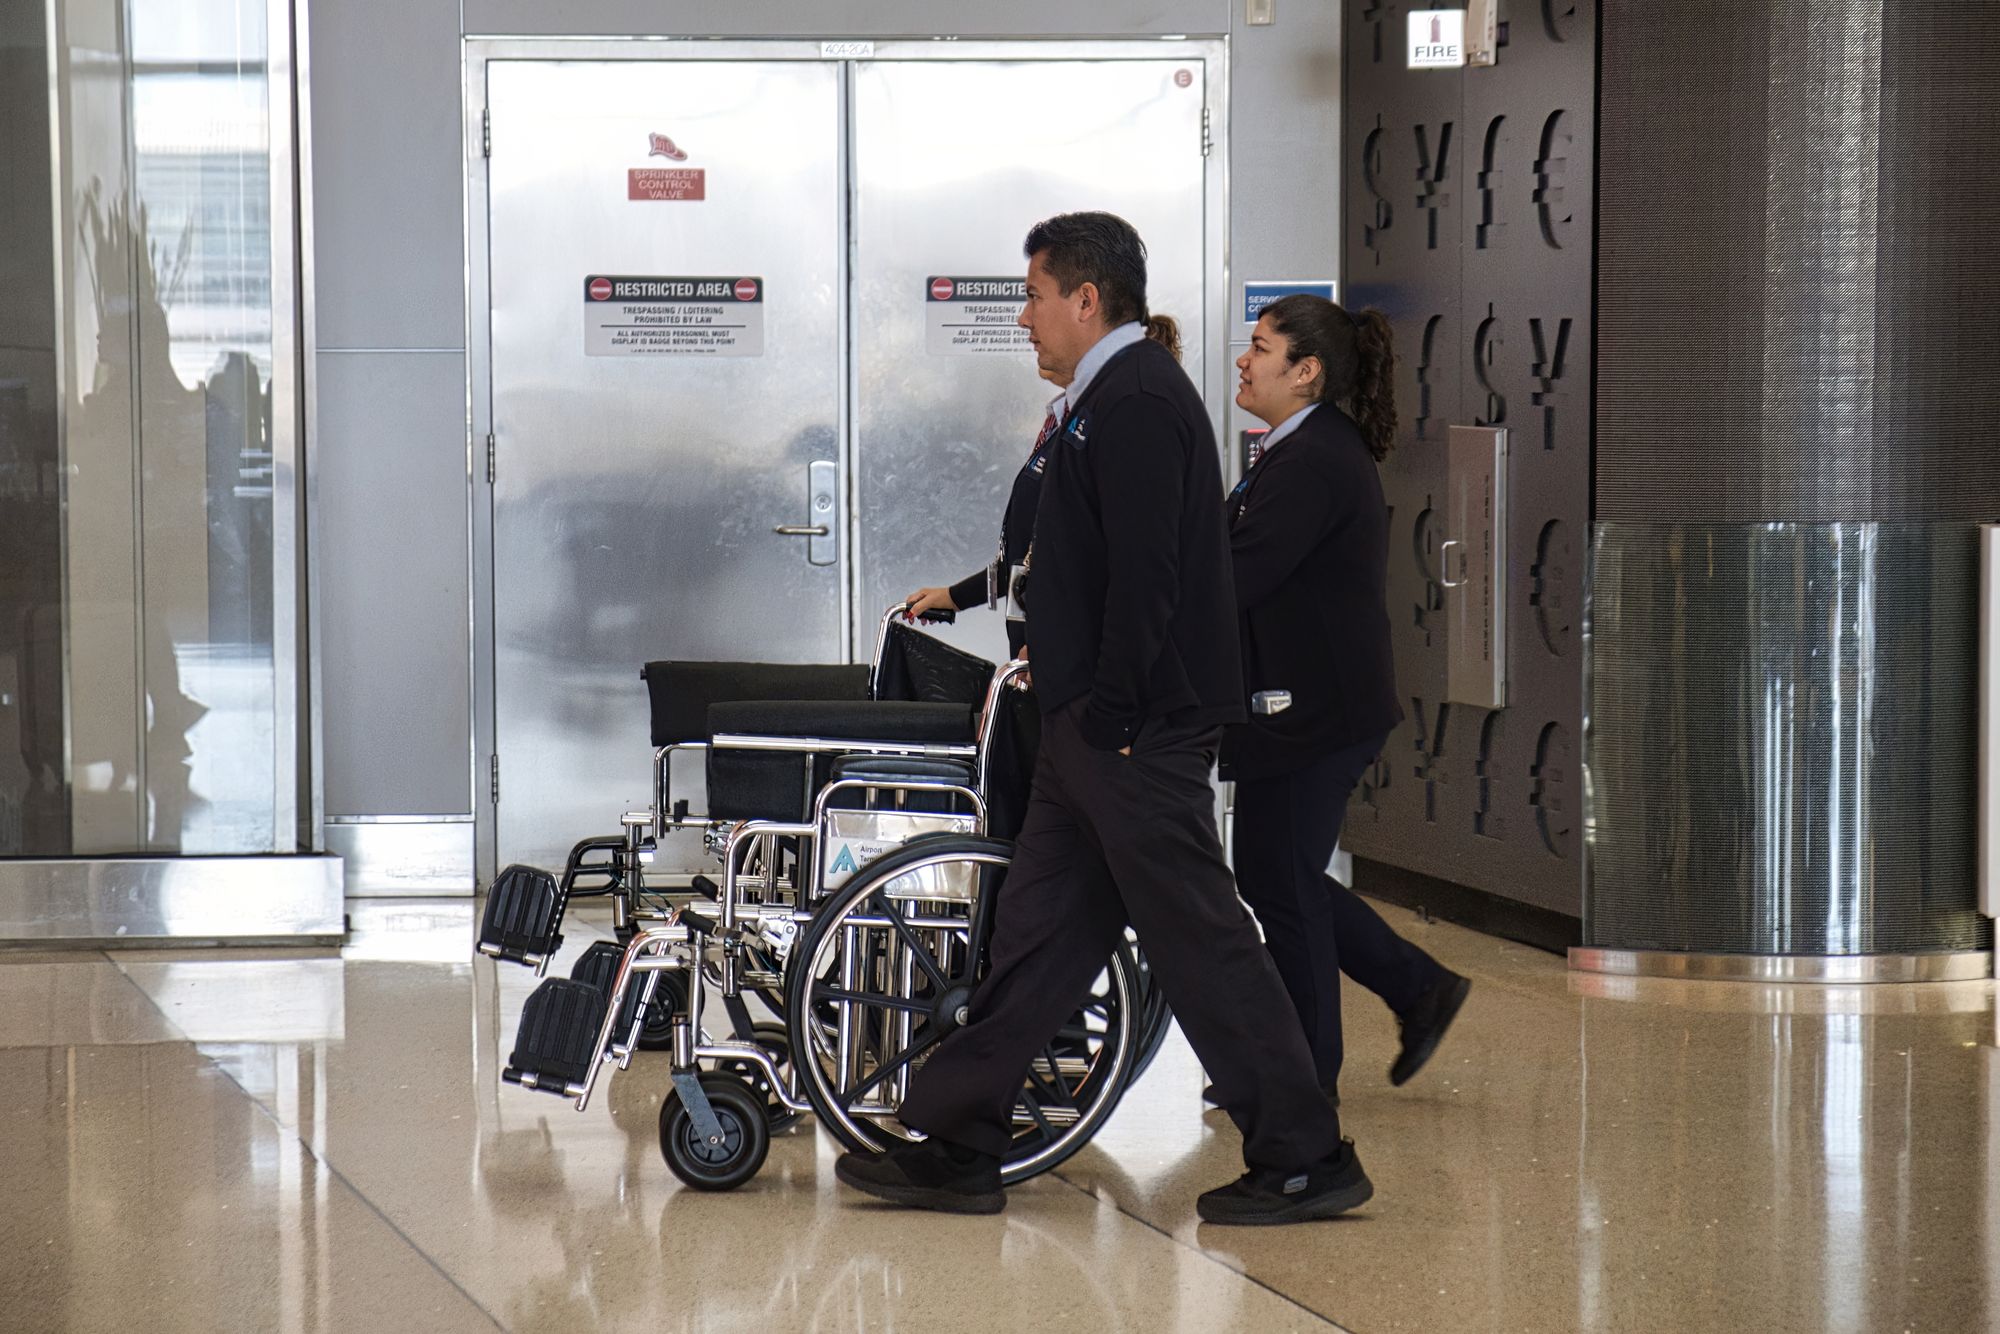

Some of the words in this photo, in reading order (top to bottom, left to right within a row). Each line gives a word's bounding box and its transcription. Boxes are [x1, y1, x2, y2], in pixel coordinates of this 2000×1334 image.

[1414, 45, 1457, 58] FIRE
[634, 170, 699, 179] SPRINKLER
[639, 180, 694, 189] CONTROL
[649, 190, 683, 199] VALVE
[615, 282, 694, 297] RESTRICTED
[696, 282, 732, 297] AREA
[957, 282, 1027, 296] RESTRICTE
[1248, 295, 1285, 304] SERVIC
[623, 306, 676, 315] TRESPASSING
[683, 306, 724, 315] LOITERING
[964, 306, 1016, 314] TRESPASSING
[634, 316, 681, 324] PROHIBITED
[682, 316, 693, 324] BY
[695, 316, 713, 324] LAW
[975, 315, 1018, 323] PROHIBITE
[860, 846, 882, 854] Airport
